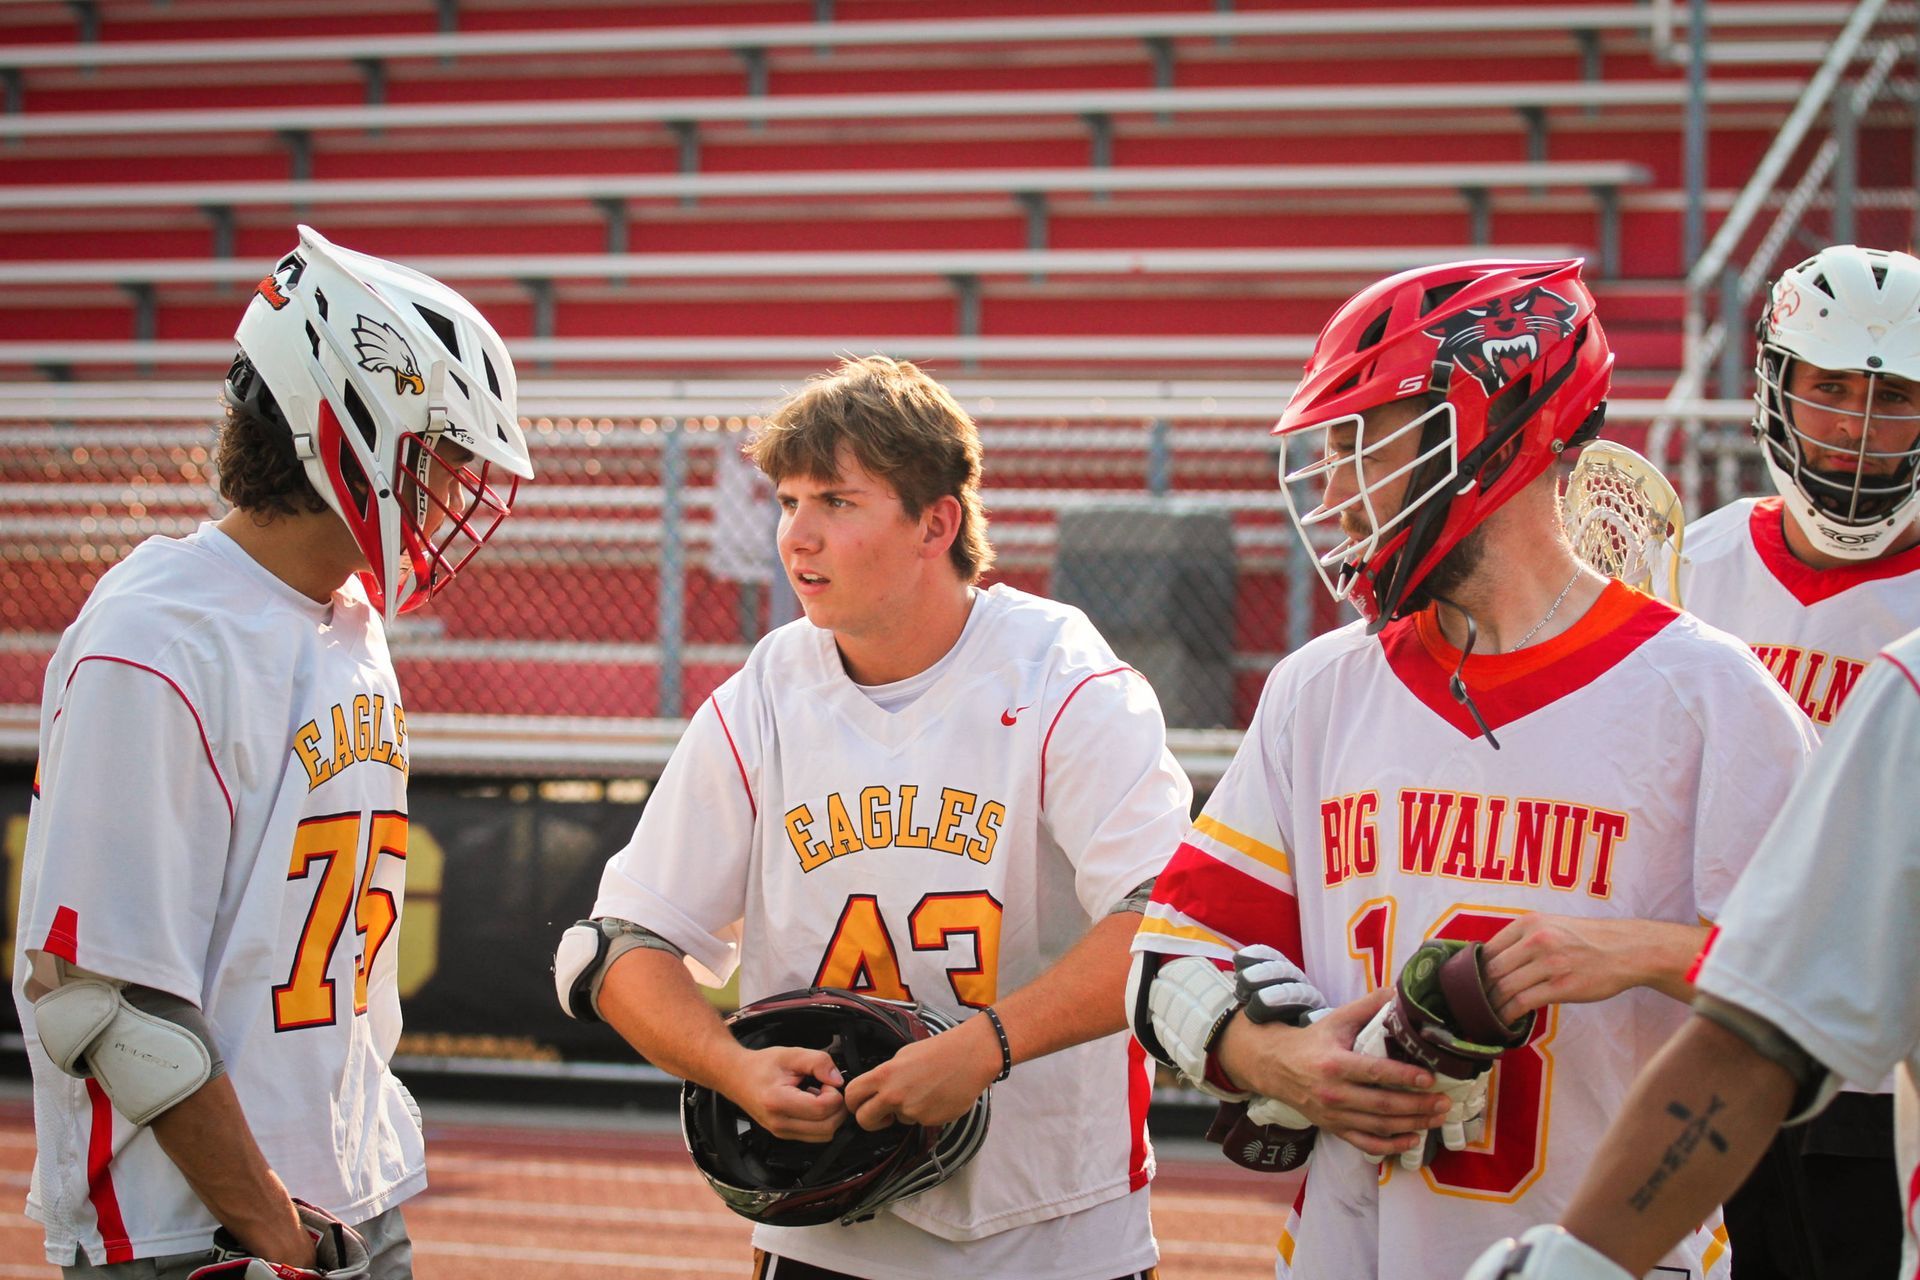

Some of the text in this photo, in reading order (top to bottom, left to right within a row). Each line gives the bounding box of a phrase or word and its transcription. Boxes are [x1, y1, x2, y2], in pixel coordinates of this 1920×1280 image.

[293, 694, 409, 794] EAGLE
[785, 784, 1006, 873] EAGLES
[1321, 787, 1629, 899] BIG WALNUT
[271, 810, 409, 1033] 75
